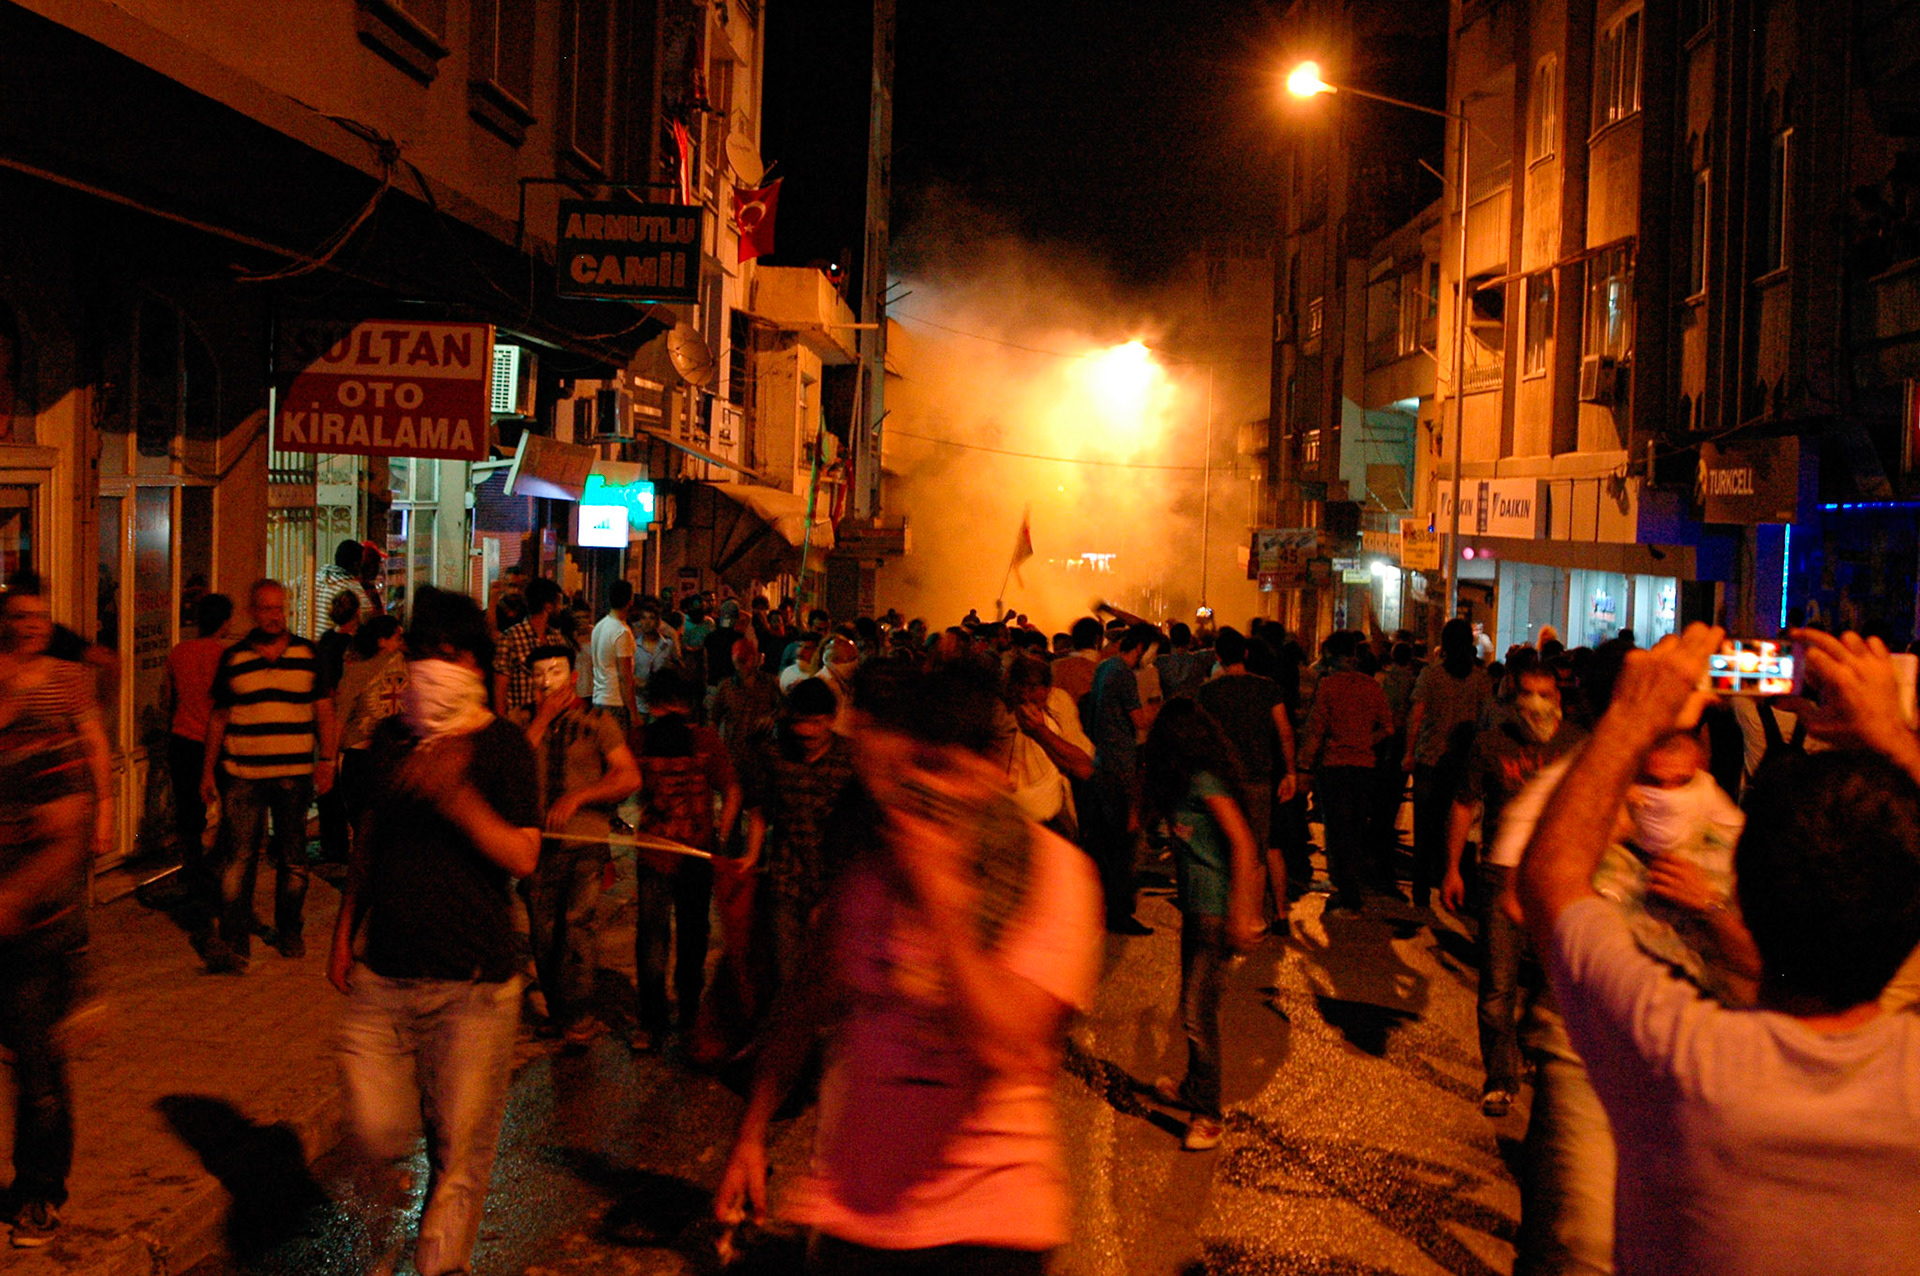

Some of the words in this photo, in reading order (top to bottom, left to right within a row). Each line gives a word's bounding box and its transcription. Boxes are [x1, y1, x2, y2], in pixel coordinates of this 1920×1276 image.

[564, 212, 696, 244] ARMUTLU
[337, 380, 424, 409] OTO
[282, 401, 475, 451] KİRALAMA
[1709, 467, 1754, 496] TURKCELL
[1500, 499, 1531, 518] DAIKIN
